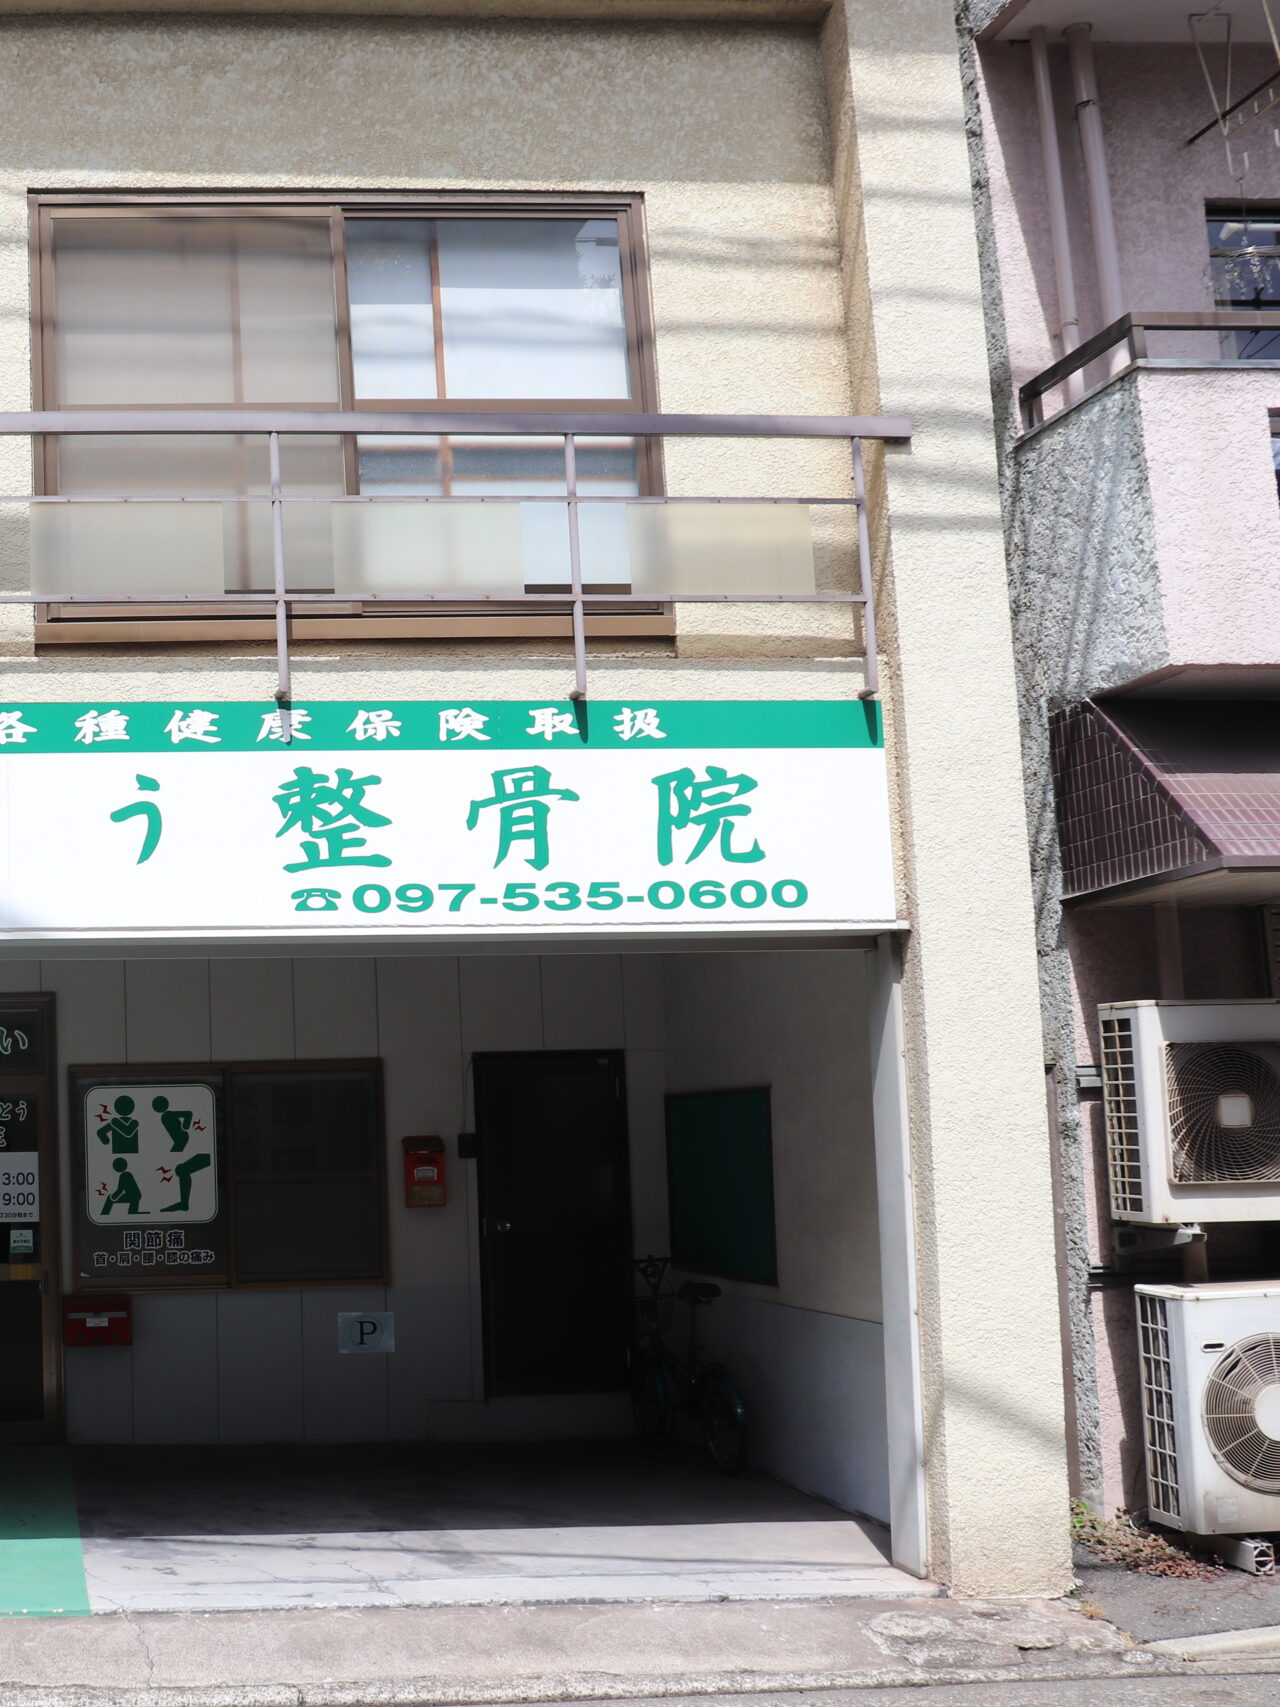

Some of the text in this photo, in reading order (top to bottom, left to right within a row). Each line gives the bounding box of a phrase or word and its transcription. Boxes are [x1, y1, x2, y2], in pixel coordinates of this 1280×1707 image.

[351, 878, 809, 913] 097-535-0600
[123, 1229, 185, 1249] 関節痛
[356, 1320, 378, 1345] P
